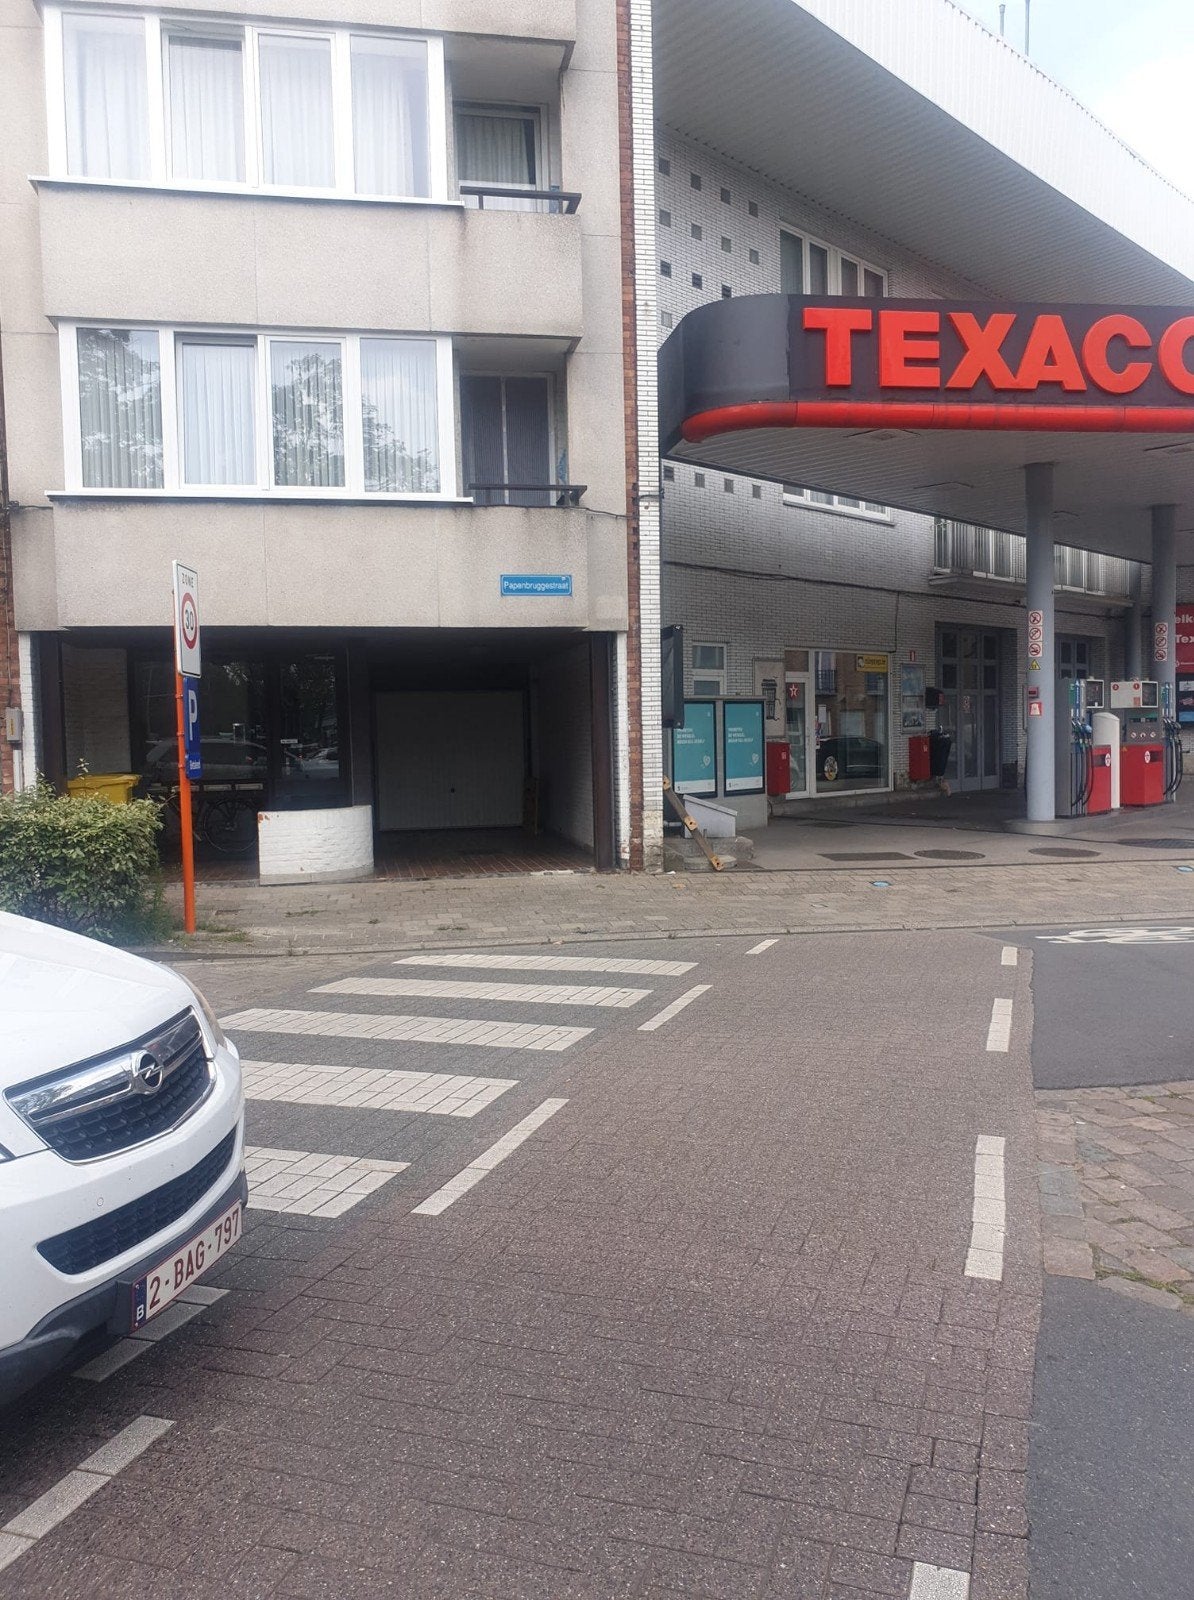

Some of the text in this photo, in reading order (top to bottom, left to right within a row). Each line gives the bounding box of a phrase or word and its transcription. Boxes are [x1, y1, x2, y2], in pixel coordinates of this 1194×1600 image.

[182, 573, 194, 588] ZONE
[504, 581, 568, 591] Papenbruggestraat
[185, 609, 194, 631] 30
[188, 690, 198, 741] P
[149, 1208, 239, 1310] 2-BAG-797
[136, 1304, 144, 1321] B
